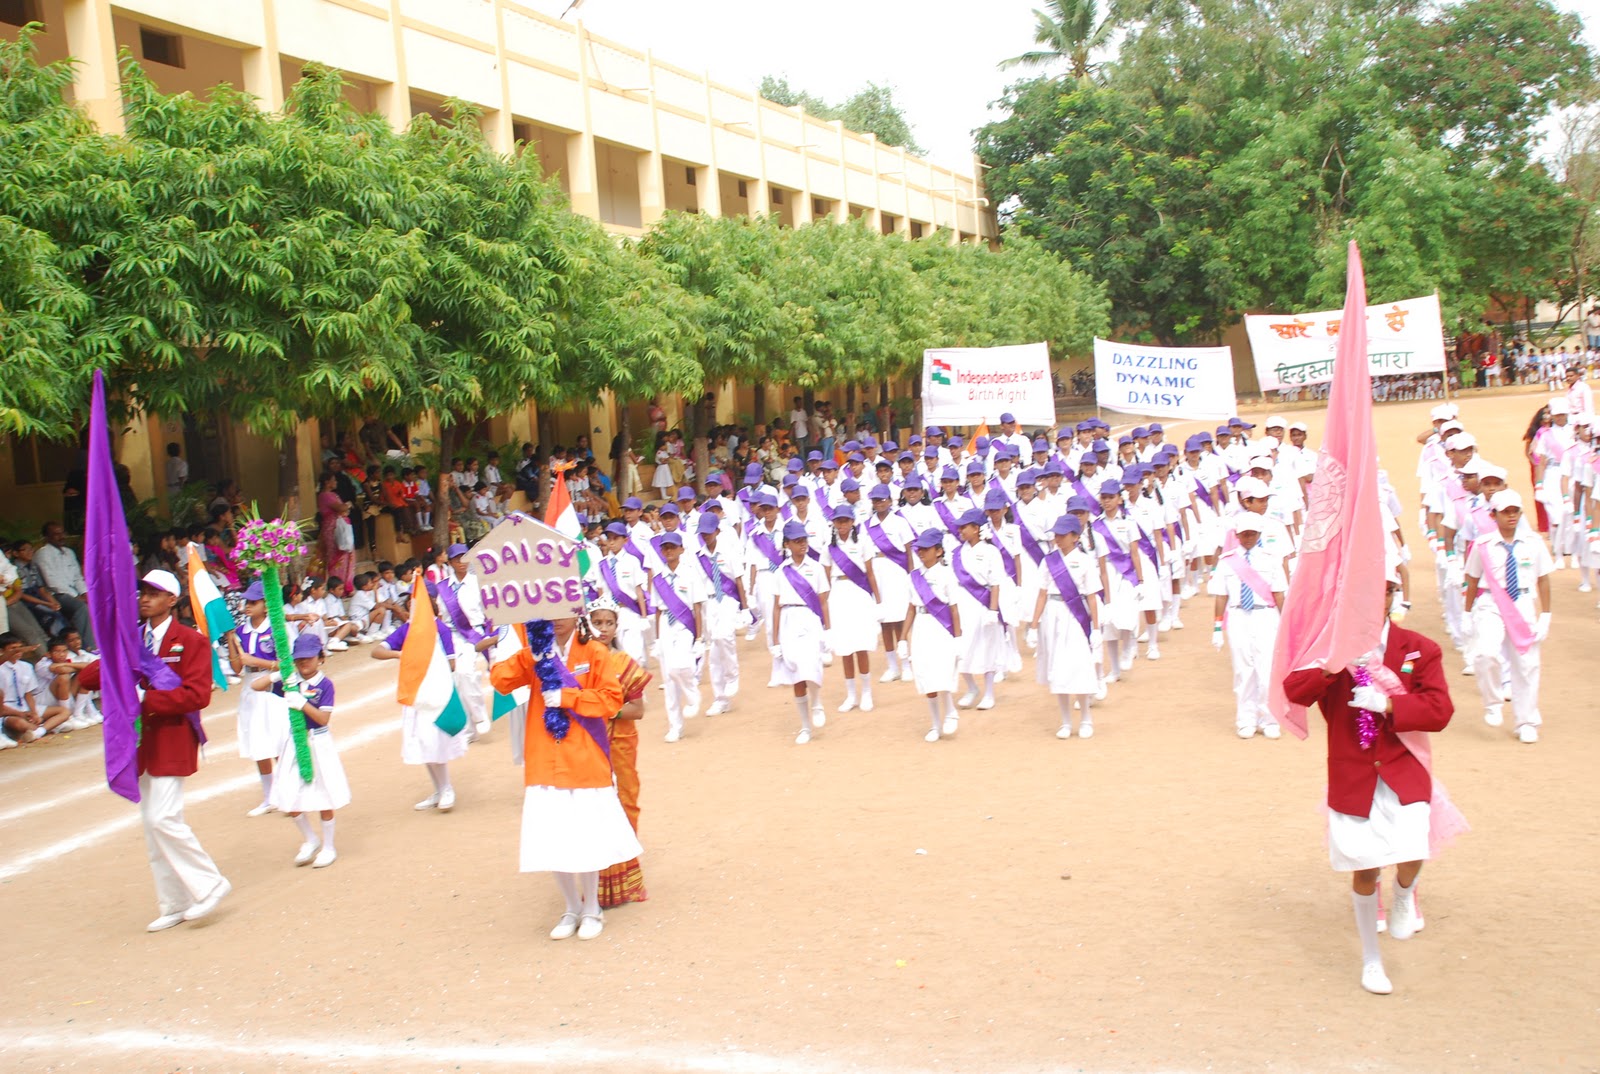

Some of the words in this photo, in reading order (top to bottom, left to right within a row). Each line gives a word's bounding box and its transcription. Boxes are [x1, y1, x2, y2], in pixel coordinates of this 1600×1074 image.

[1112, 352, 1198, 371] DAZZLING
[956, 368, 1019, 385] Independence
[1020, 372, 1028, 382] is
[1029, 369, 1045, 381] our
[1116, 371, 1195, 389] DYNAMIC
[968, 387, 994, 401] Birth
[997, 387, 1027, 404] Right
[1127, 390, 1185, 407] DAISY
[476, 539, 577, 575] DAISY
[480, 577, 582, 610] HOUSE
